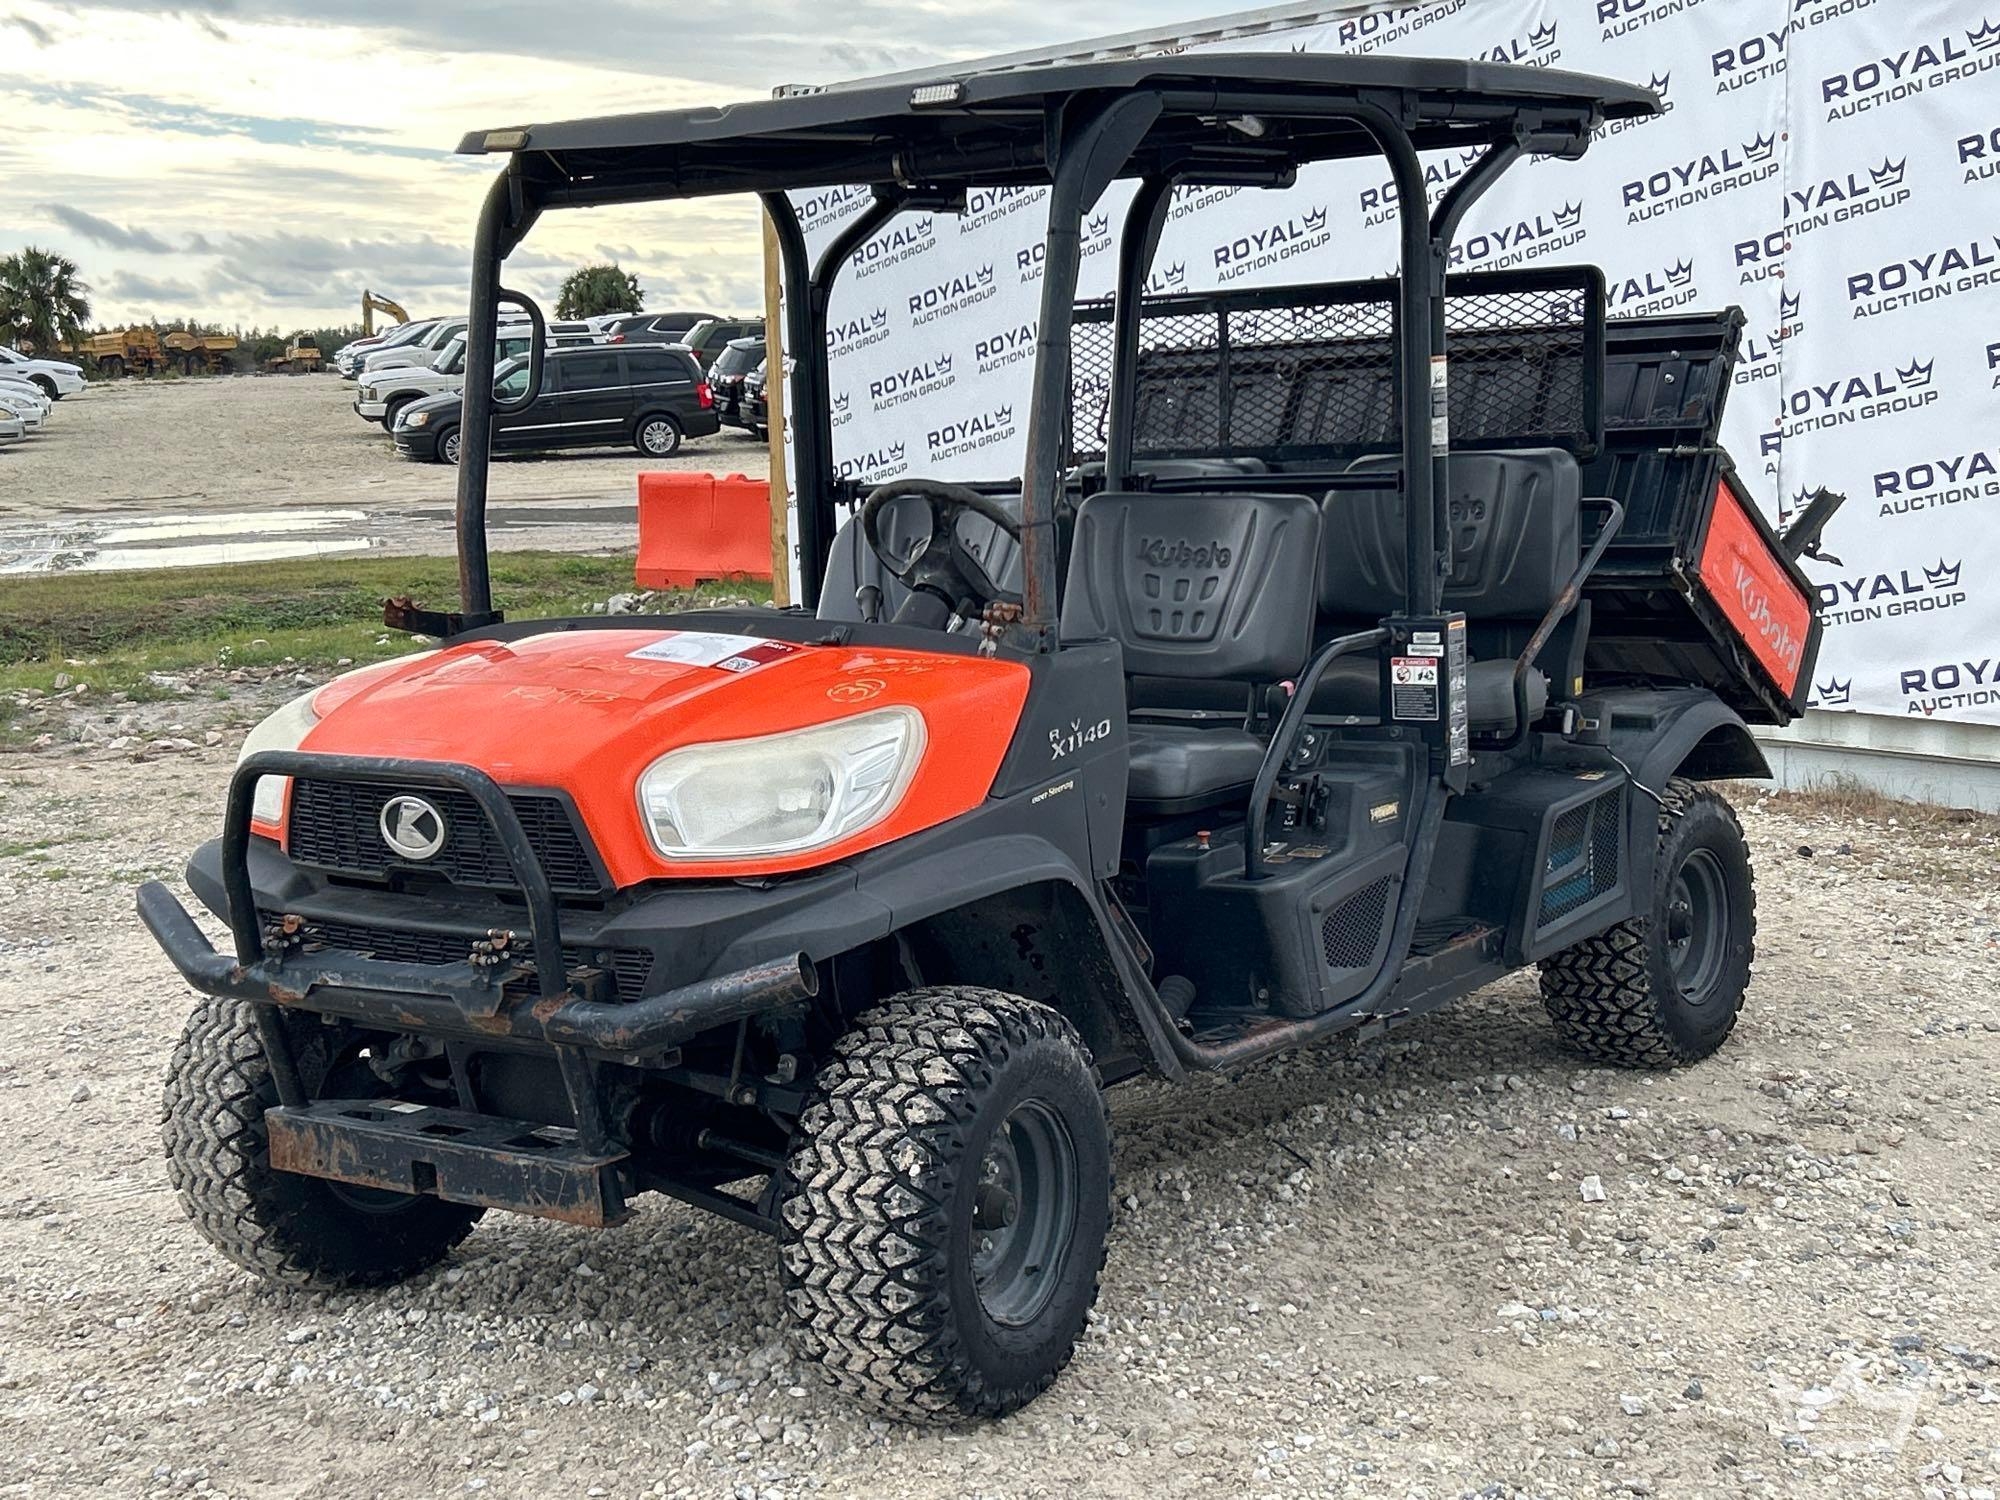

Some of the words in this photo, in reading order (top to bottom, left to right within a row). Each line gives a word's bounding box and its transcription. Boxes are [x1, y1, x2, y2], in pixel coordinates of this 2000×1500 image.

[1602, 0, 1683, 42] AUCTION
[1810, 0, 1877, 25] GROU
[1345, 23, 1409, 55] UCTION
[1712, 25, 1789, 77] ROY
[1716, 58, 1787, 95] AUCTIO
[1822, 37, 1966, 103] ROYAL
[1827, 79, 1923, 123] AUCTION
[1196, 186, 1242, 210] GROUP
[1360, 159, 1461, 212] ROAL
[1622, 149, 1743, 207] ROYAL
[1627, 187, 1707, 225] AUCTION
[1710, 163, 1779, 196] GROUP
[1784, 174, 1869, 219] YAL
[795, 185, 853, 221] ROYAL
[801, 211, 837, 234] UCTION
[838, 195, 872, 218] GROUP
[960, 206, 1006, 235] AUCTION
[1008, 188, 1046, 213] GROUP
[1784, 213, 1828, 238] TION
[1834, 189, 1910, 223] GROUP
[853, 226, 917, 267] ROYAL
[856, 256, 899, 281] AUCTION
[901, 238, 936, 260] GROUP
[1080, 238, 1112, 258] ROUP
[1214, 220, 1303, 268] ROYAL
[1218, 249, 1277, 284] AUCTION
[1280, 232, 1331, 260] GROUP
[1448, 216, 1553, 269] ROYAL
[1467, 251, 1522, 273] CTION
[1526, 229, 1586, 259] GROUP
[1848, 242, 1994, 301] ROYAL
[909, 272, 977, 314] ROYAL
[912, 299, 958, 327] AUCTION
[960, 286, 996, 309] GROUP
[1635, 288, 1697, 319] GROUP
[1853, 282, 1952, 319] AUCTION
[1957, 267, 2000, 292] GRO
[826, 318, 871, 347] OYAL
[856, 329, 890, 350] GROUP
[870, 362, 936, 399] ROYAL
[979, 351, 1025, 374] AUCTION
[1735, 362, 1781, 385] GRO
[873, 390, 917, 413] AUCTION
[919, 375, 956, 397] GROUP
[1781, 409, 1855, 438] UCTION
[1860, 390, 1938, 420] GROUP
[832, 412, 852, 427] OUP
[927, 413, 995, 449] ROYAL
[833, 450, 889, 481] ROYAL
[930, 440, 976, 463] AUCTION
[978, 427, 1015, 449] GROUP
[874, 463, 908, 481] GROUP
[1874, 452, 1997, 498] ROYA
[1879, 485, 1980, 517] AUCTION
[1137, 538, 1231, 569] Kubota
[1732, 557, 1799, 674] Kubota
[1821, 605, 1881, 628] CTION
[1887, 592, 1966, 617] GROUP
[1901, 659, 2000, 694] ROY
[1051, 719, 1110, 760] X1140
